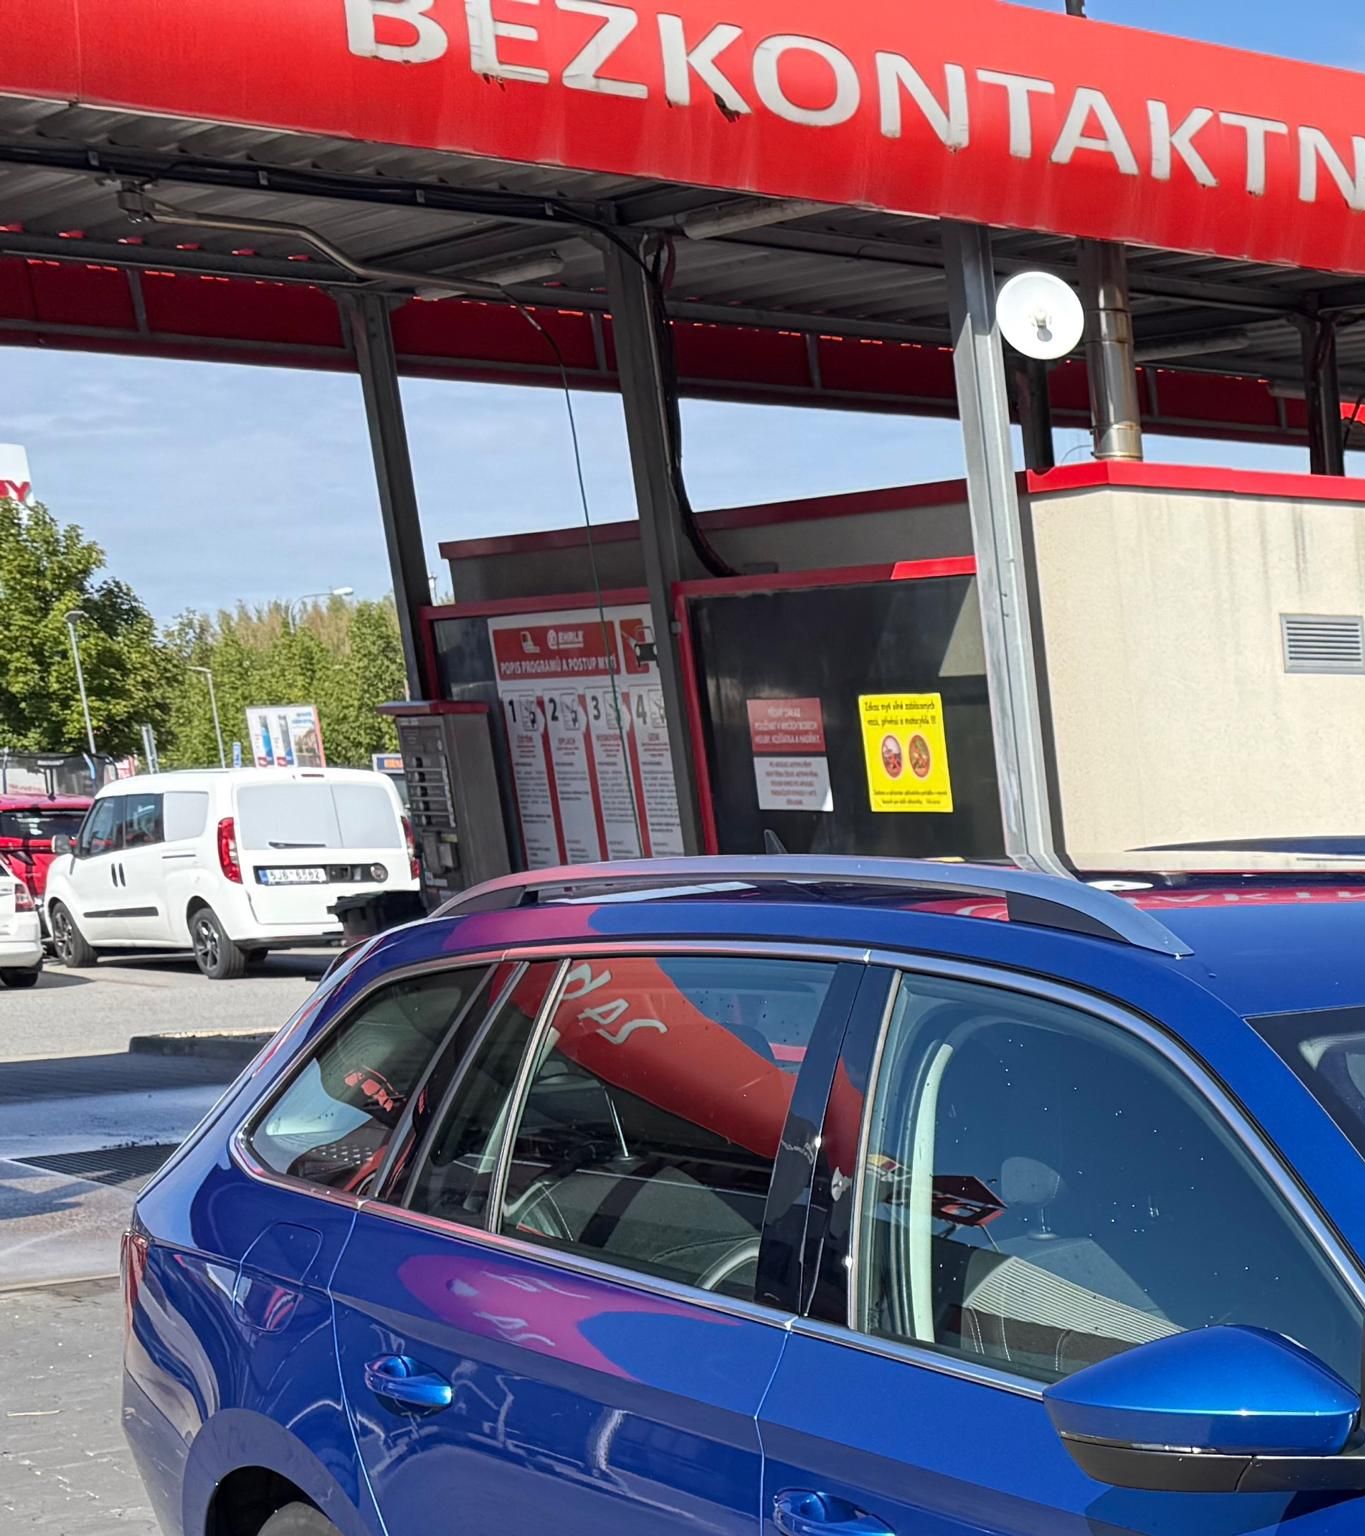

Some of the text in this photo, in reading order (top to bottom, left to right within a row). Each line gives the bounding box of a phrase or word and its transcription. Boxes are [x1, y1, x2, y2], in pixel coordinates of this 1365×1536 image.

[508, 699, 517, 724] 1
[548, 698, 559, 722] 2
[591, 695, 601, 721] 3
[636, 694, 647, 725] 4
